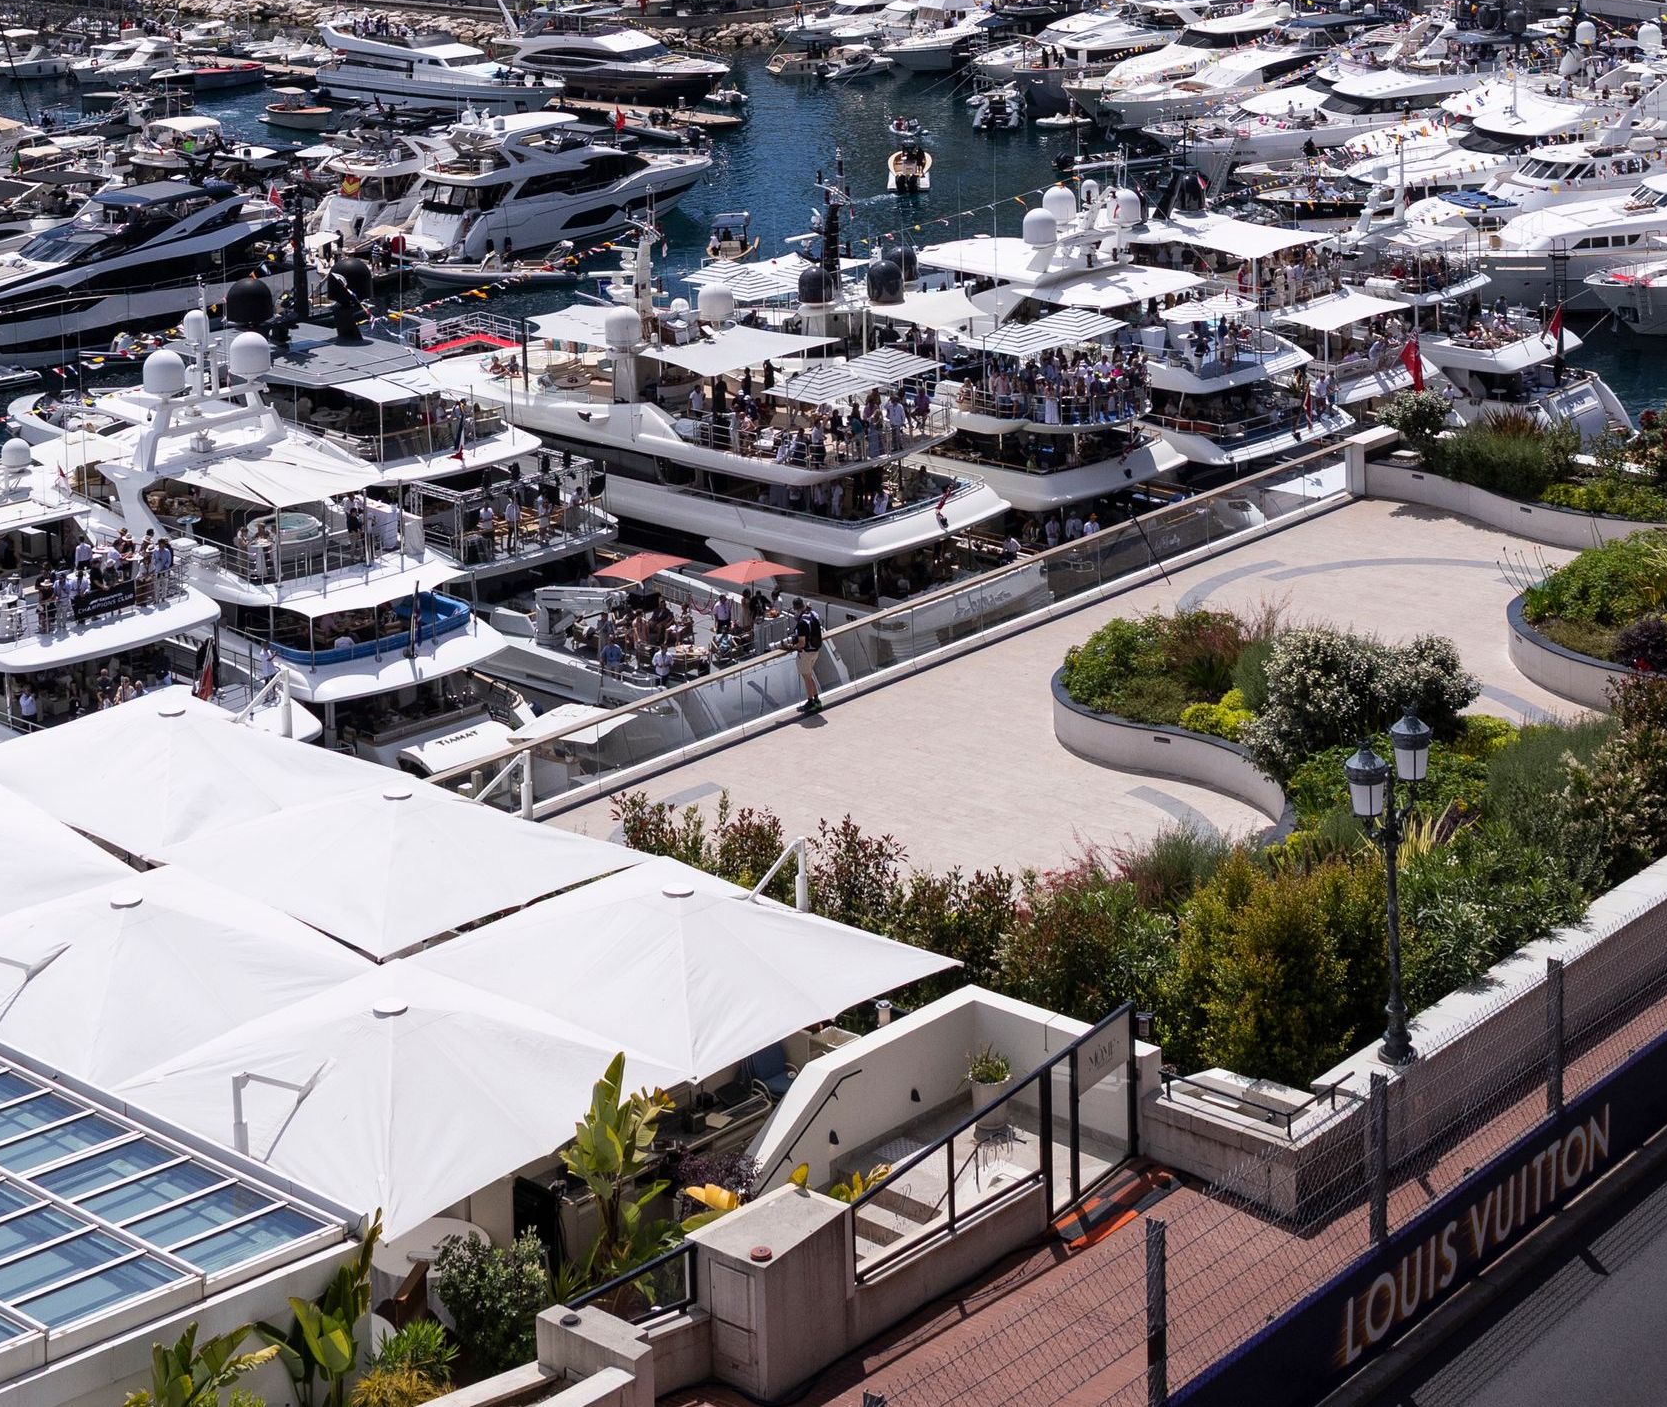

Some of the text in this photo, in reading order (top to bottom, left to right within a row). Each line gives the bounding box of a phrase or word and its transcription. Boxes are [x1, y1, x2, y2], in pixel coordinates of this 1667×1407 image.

[78, 599, 117, 614] CHAMPIONS
[117, 593, 134, 603] CLUB
[435, 729, 479, 746] TIAMAT
[1345, 1102, 1610, 1364] LOUIS VUITTON
